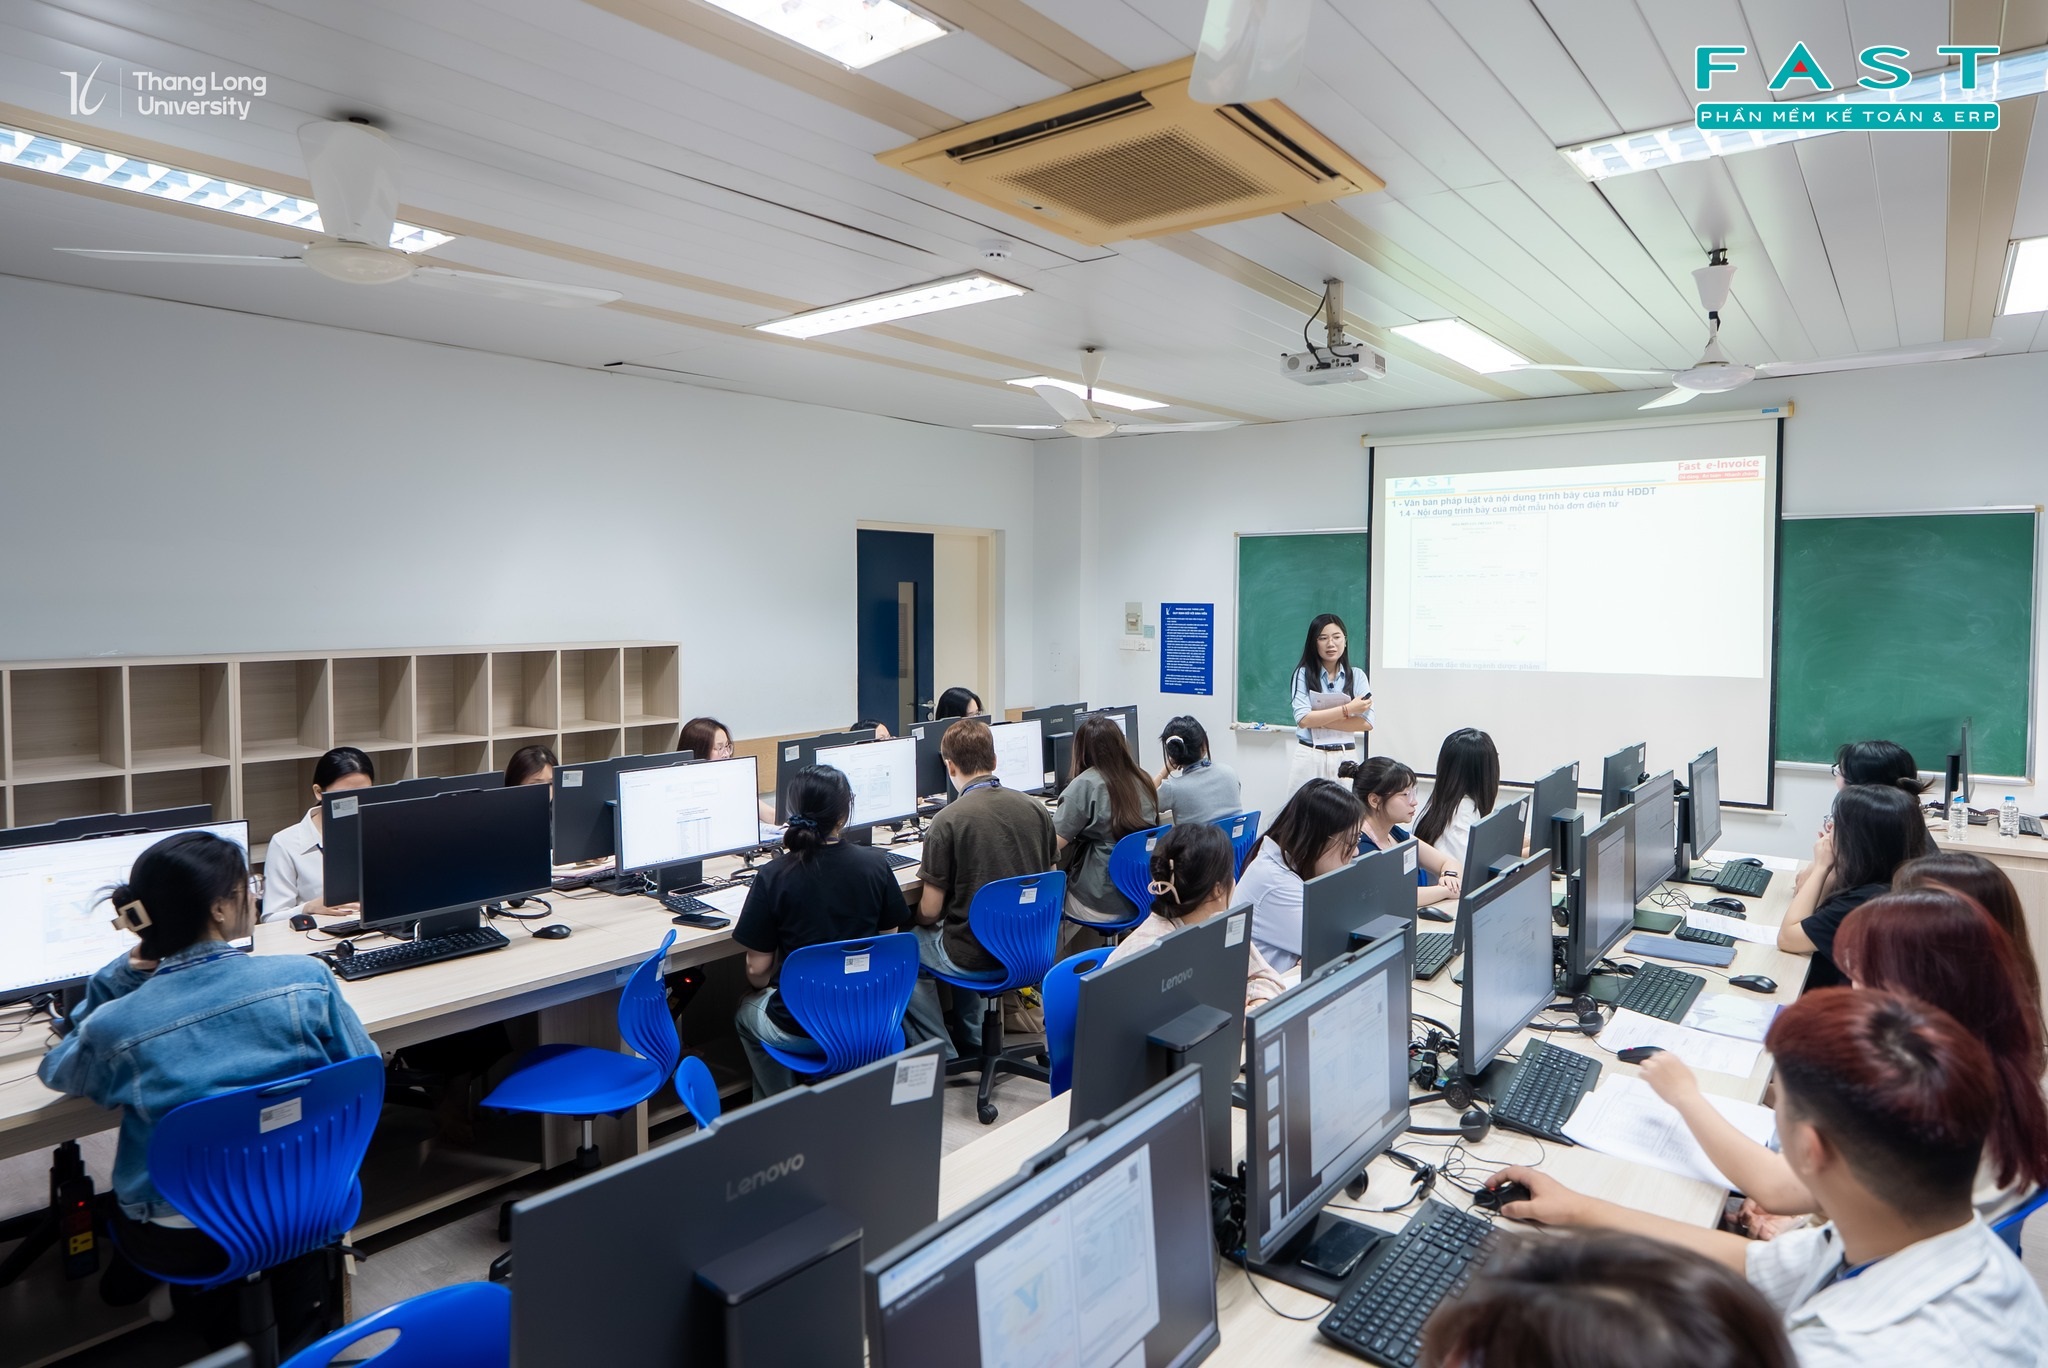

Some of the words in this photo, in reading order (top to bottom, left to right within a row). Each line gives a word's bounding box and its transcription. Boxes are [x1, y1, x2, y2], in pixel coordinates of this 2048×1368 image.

[1678, 462, 1701, 471] Fast
[1706, 458, 1760, 470] e-Invoice
[1395, 476, 1456, 488] FAST
[1512, 493, 1536, 503] dung
[1432, 508, 1453, 517] dung
[1161, 967, 1193, 993] Lenovo
[725, 1153, 805, 1202] Lenovo
